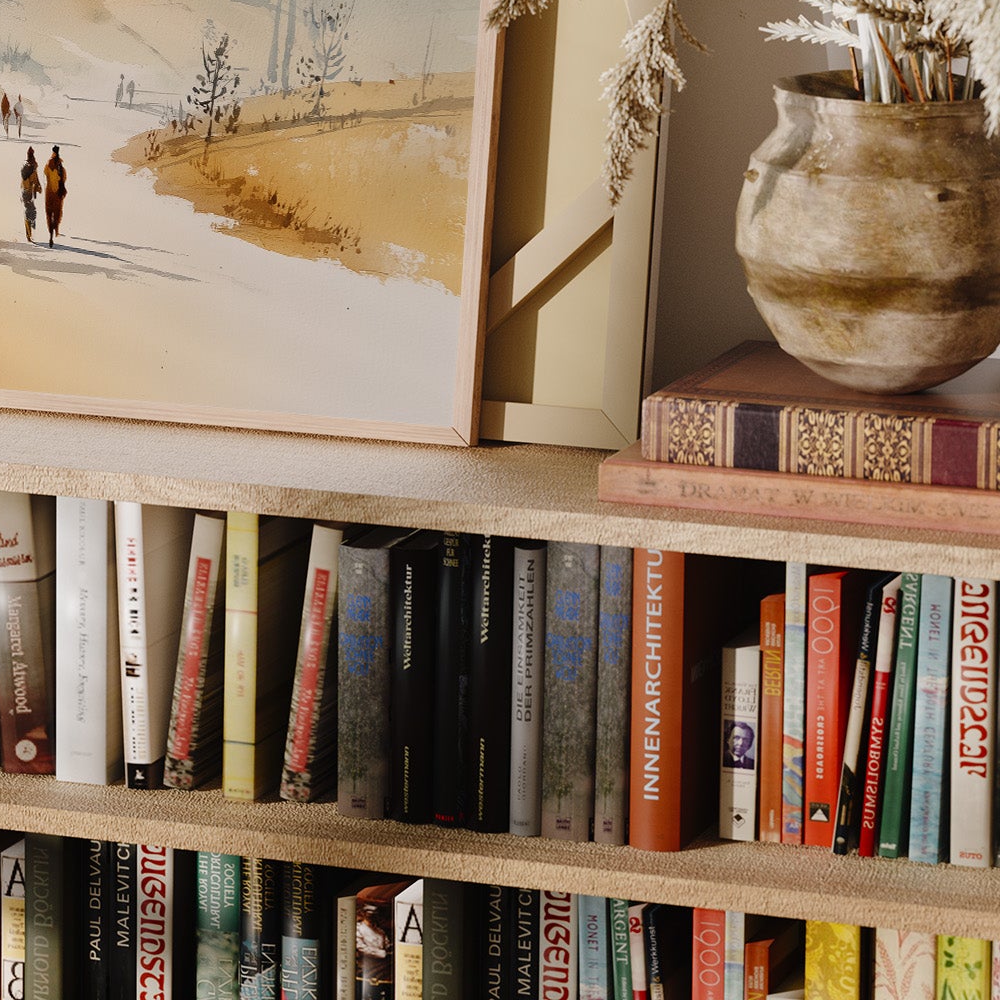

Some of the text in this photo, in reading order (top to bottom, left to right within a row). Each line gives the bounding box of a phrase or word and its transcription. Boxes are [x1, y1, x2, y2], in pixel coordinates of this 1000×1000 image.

[6, 595, 32, 714] Margaret Atwood
[403, 563, 412, 670] Weltarchitektur
[515, 576, 525, 685] EINSAMKEIT
[524, 558, 536, 722] DER PRIMZAHLEN
[89, 840, 102, 961] PAUL DELVAU
[488, 886, 501, 958] DELVAU
[586, 914, 599, 951] MONET
[648, 925, 659, 975] Werkkunst
[693, 921, 721, 987] 1900
